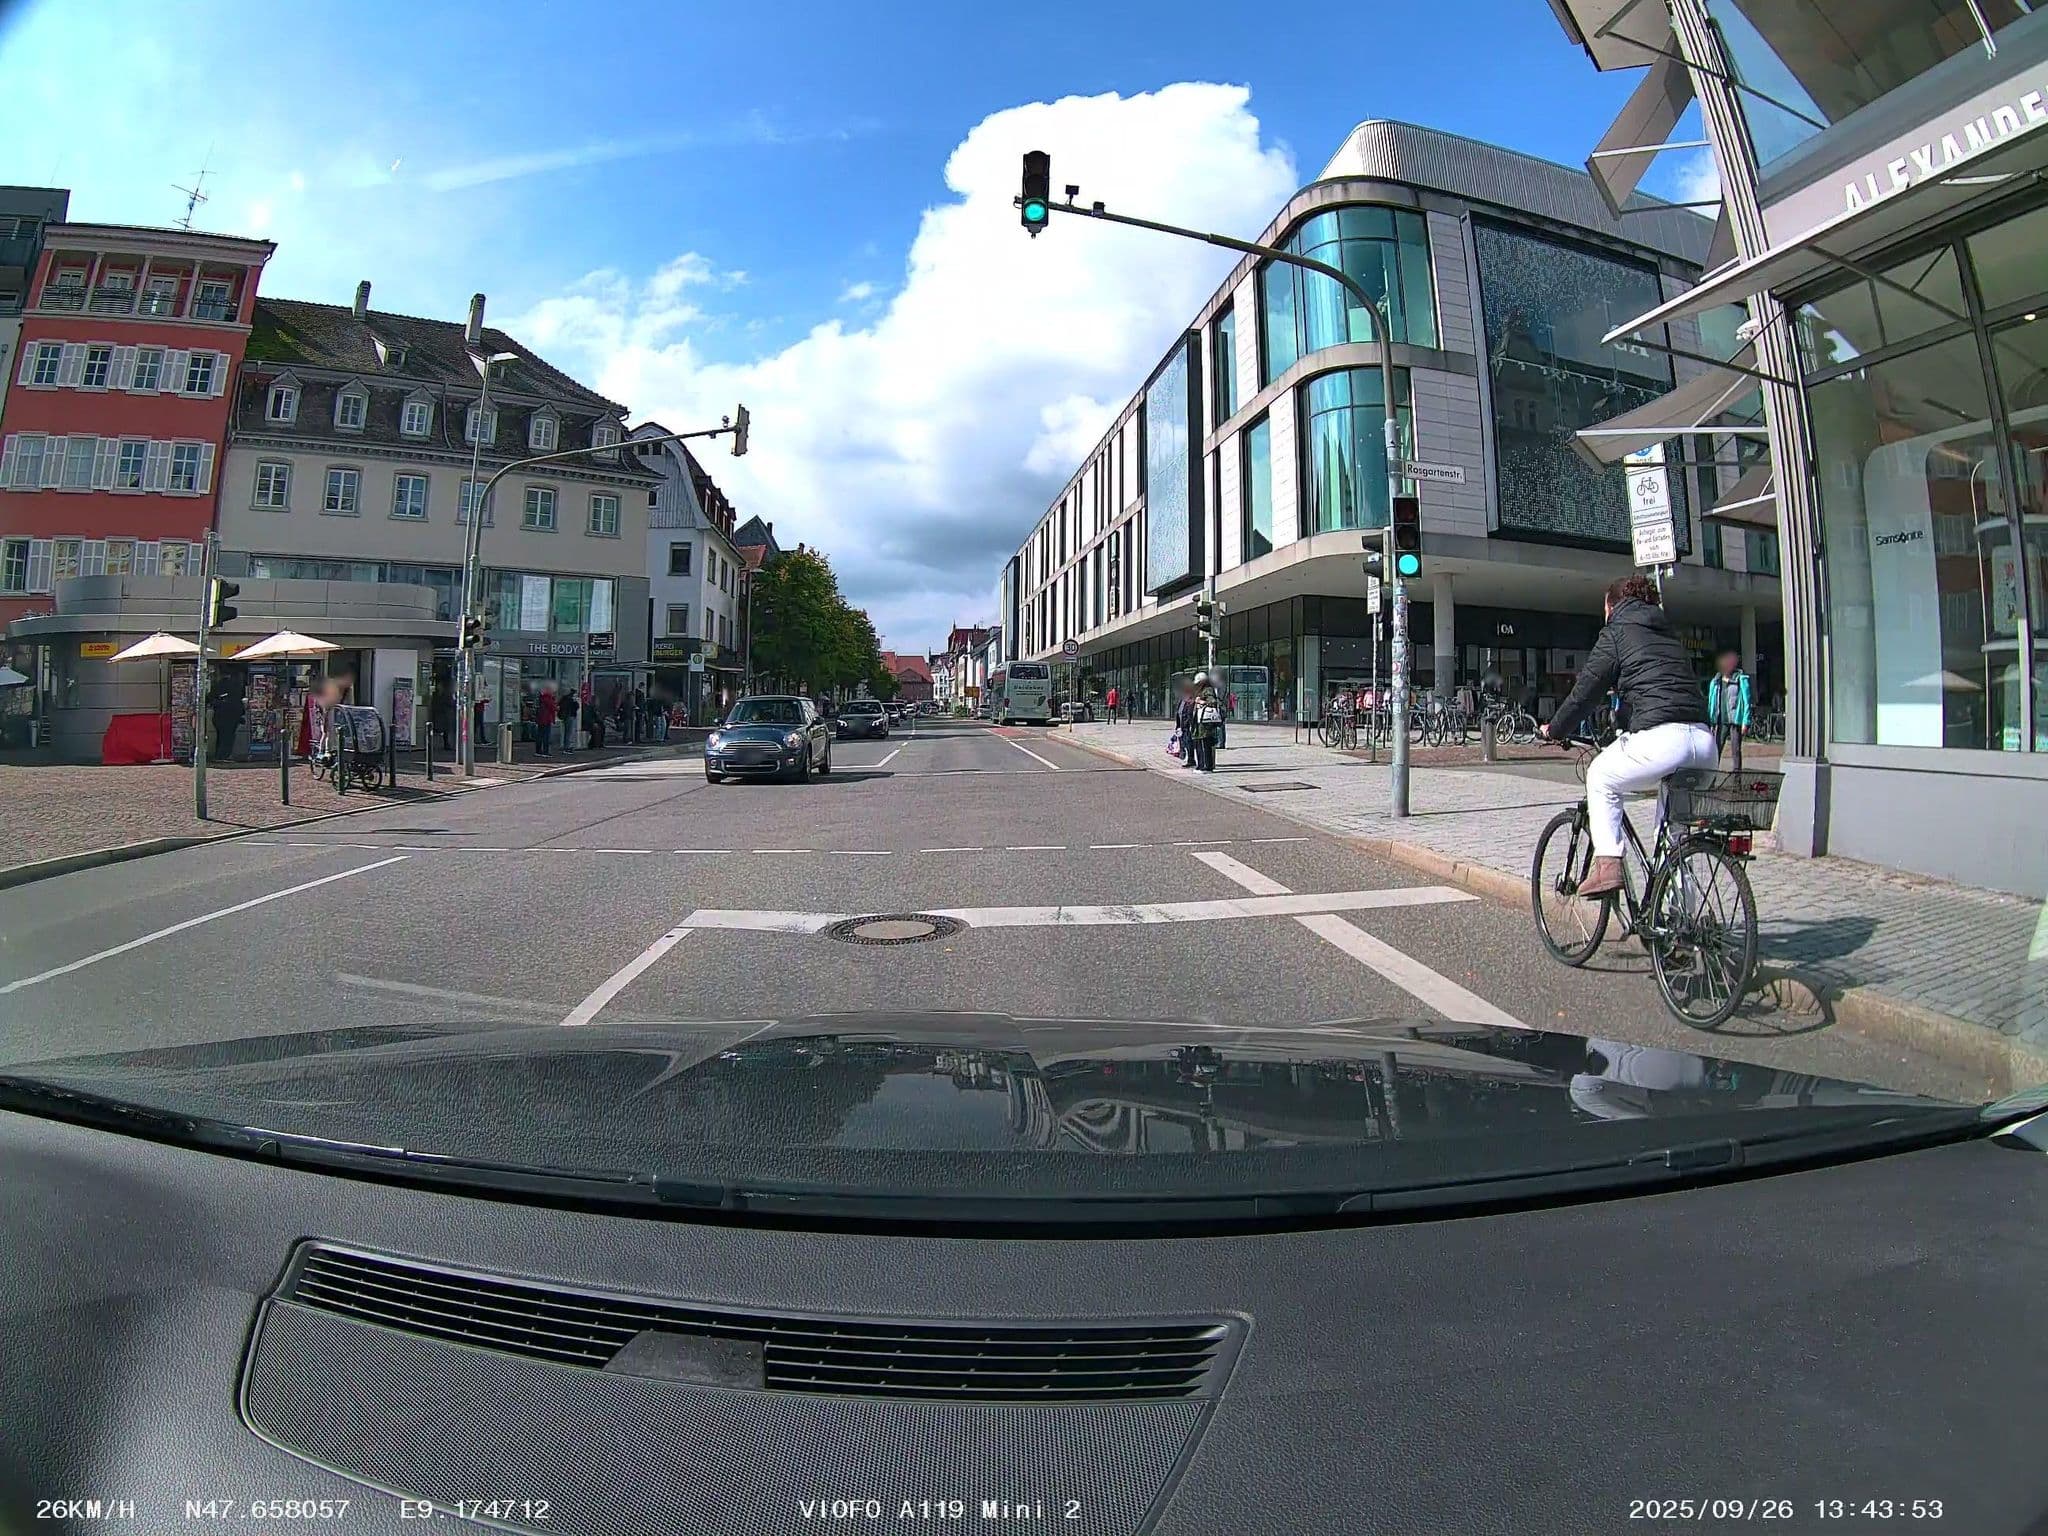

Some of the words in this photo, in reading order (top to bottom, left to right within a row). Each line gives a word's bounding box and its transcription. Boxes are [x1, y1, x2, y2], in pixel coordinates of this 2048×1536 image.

[1843, 84, 2048, 212] ALEXANDE
[1643, 495, 1656, 505] frei
[1876, 530, 1924, 546] Samsonite
[528, 643, 548, 654] THE
[551, 644, 578, 655] BODY
